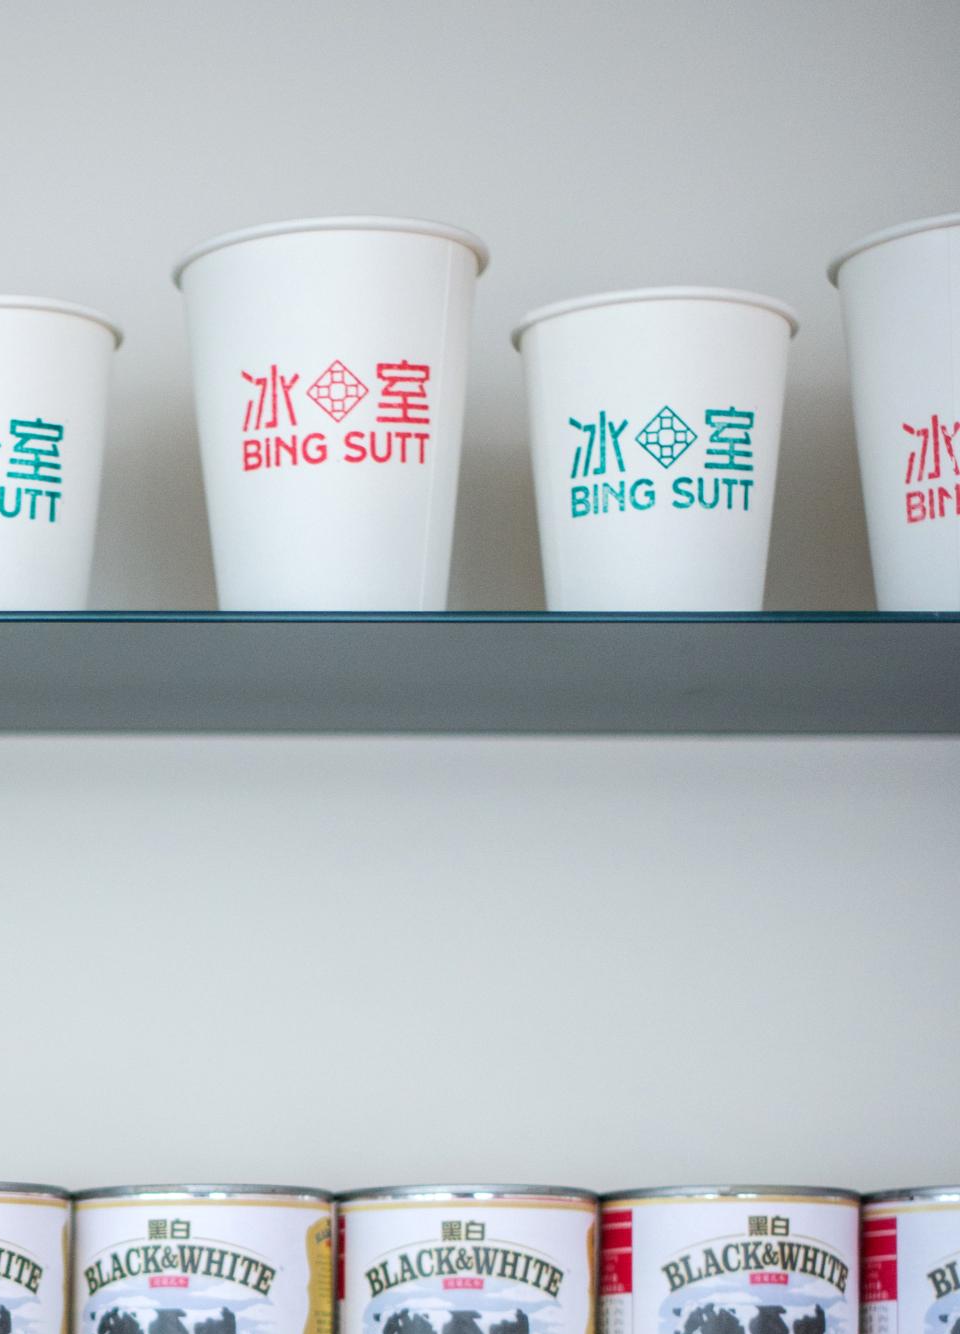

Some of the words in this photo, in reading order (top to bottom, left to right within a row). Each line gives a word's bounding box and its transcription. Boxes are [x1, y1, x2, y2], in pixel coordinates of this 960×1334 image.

[242, 432, 327, 471] BING
[343, 431, 430, 465] SUTT
[571, 478, 655, 518] BING
[671, 477, 754, 511] SUTT
[148, 1218, 191, 1240] 黑白
[442, 1220, 486, 1241] 黑白
[748, 1215, 790, 1237] 黑白
